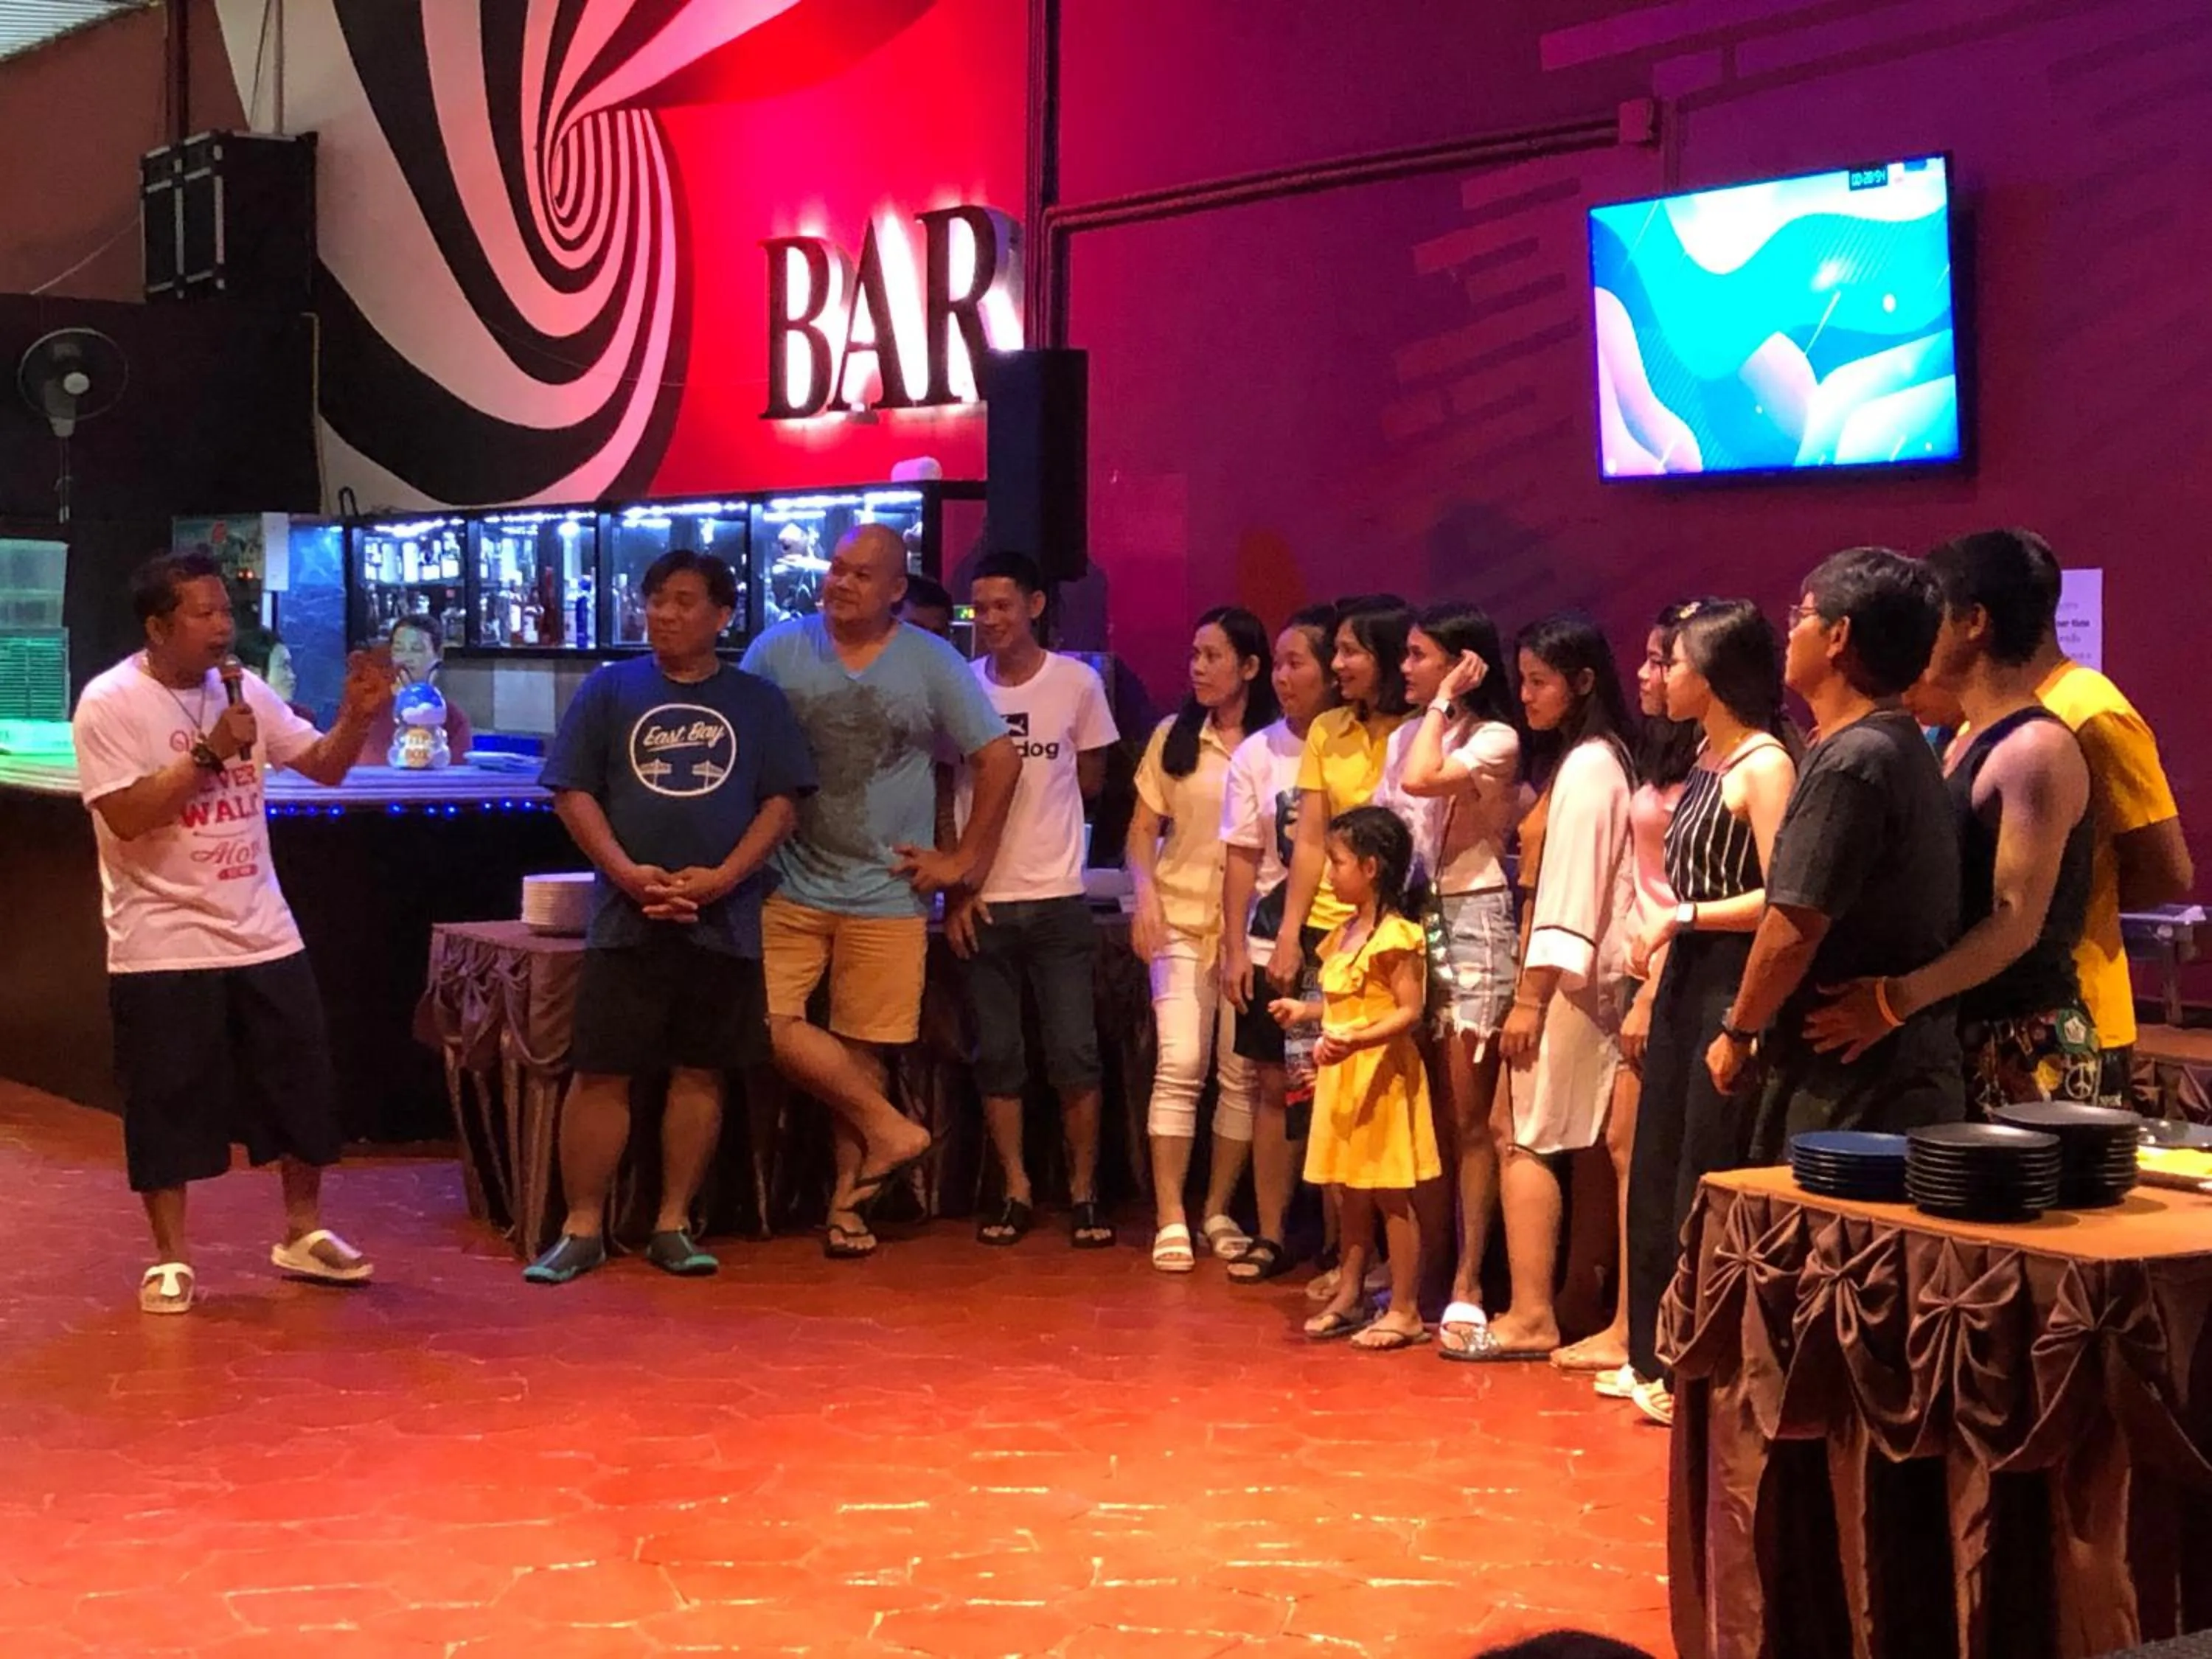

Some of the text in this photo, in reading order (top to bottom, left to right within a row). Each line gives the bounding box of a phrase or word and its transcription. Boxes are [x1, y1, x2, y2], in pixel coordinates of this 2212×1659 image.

[757, 204, 1000, 420] BAR
[643, 721, 724, 748] East Bay
